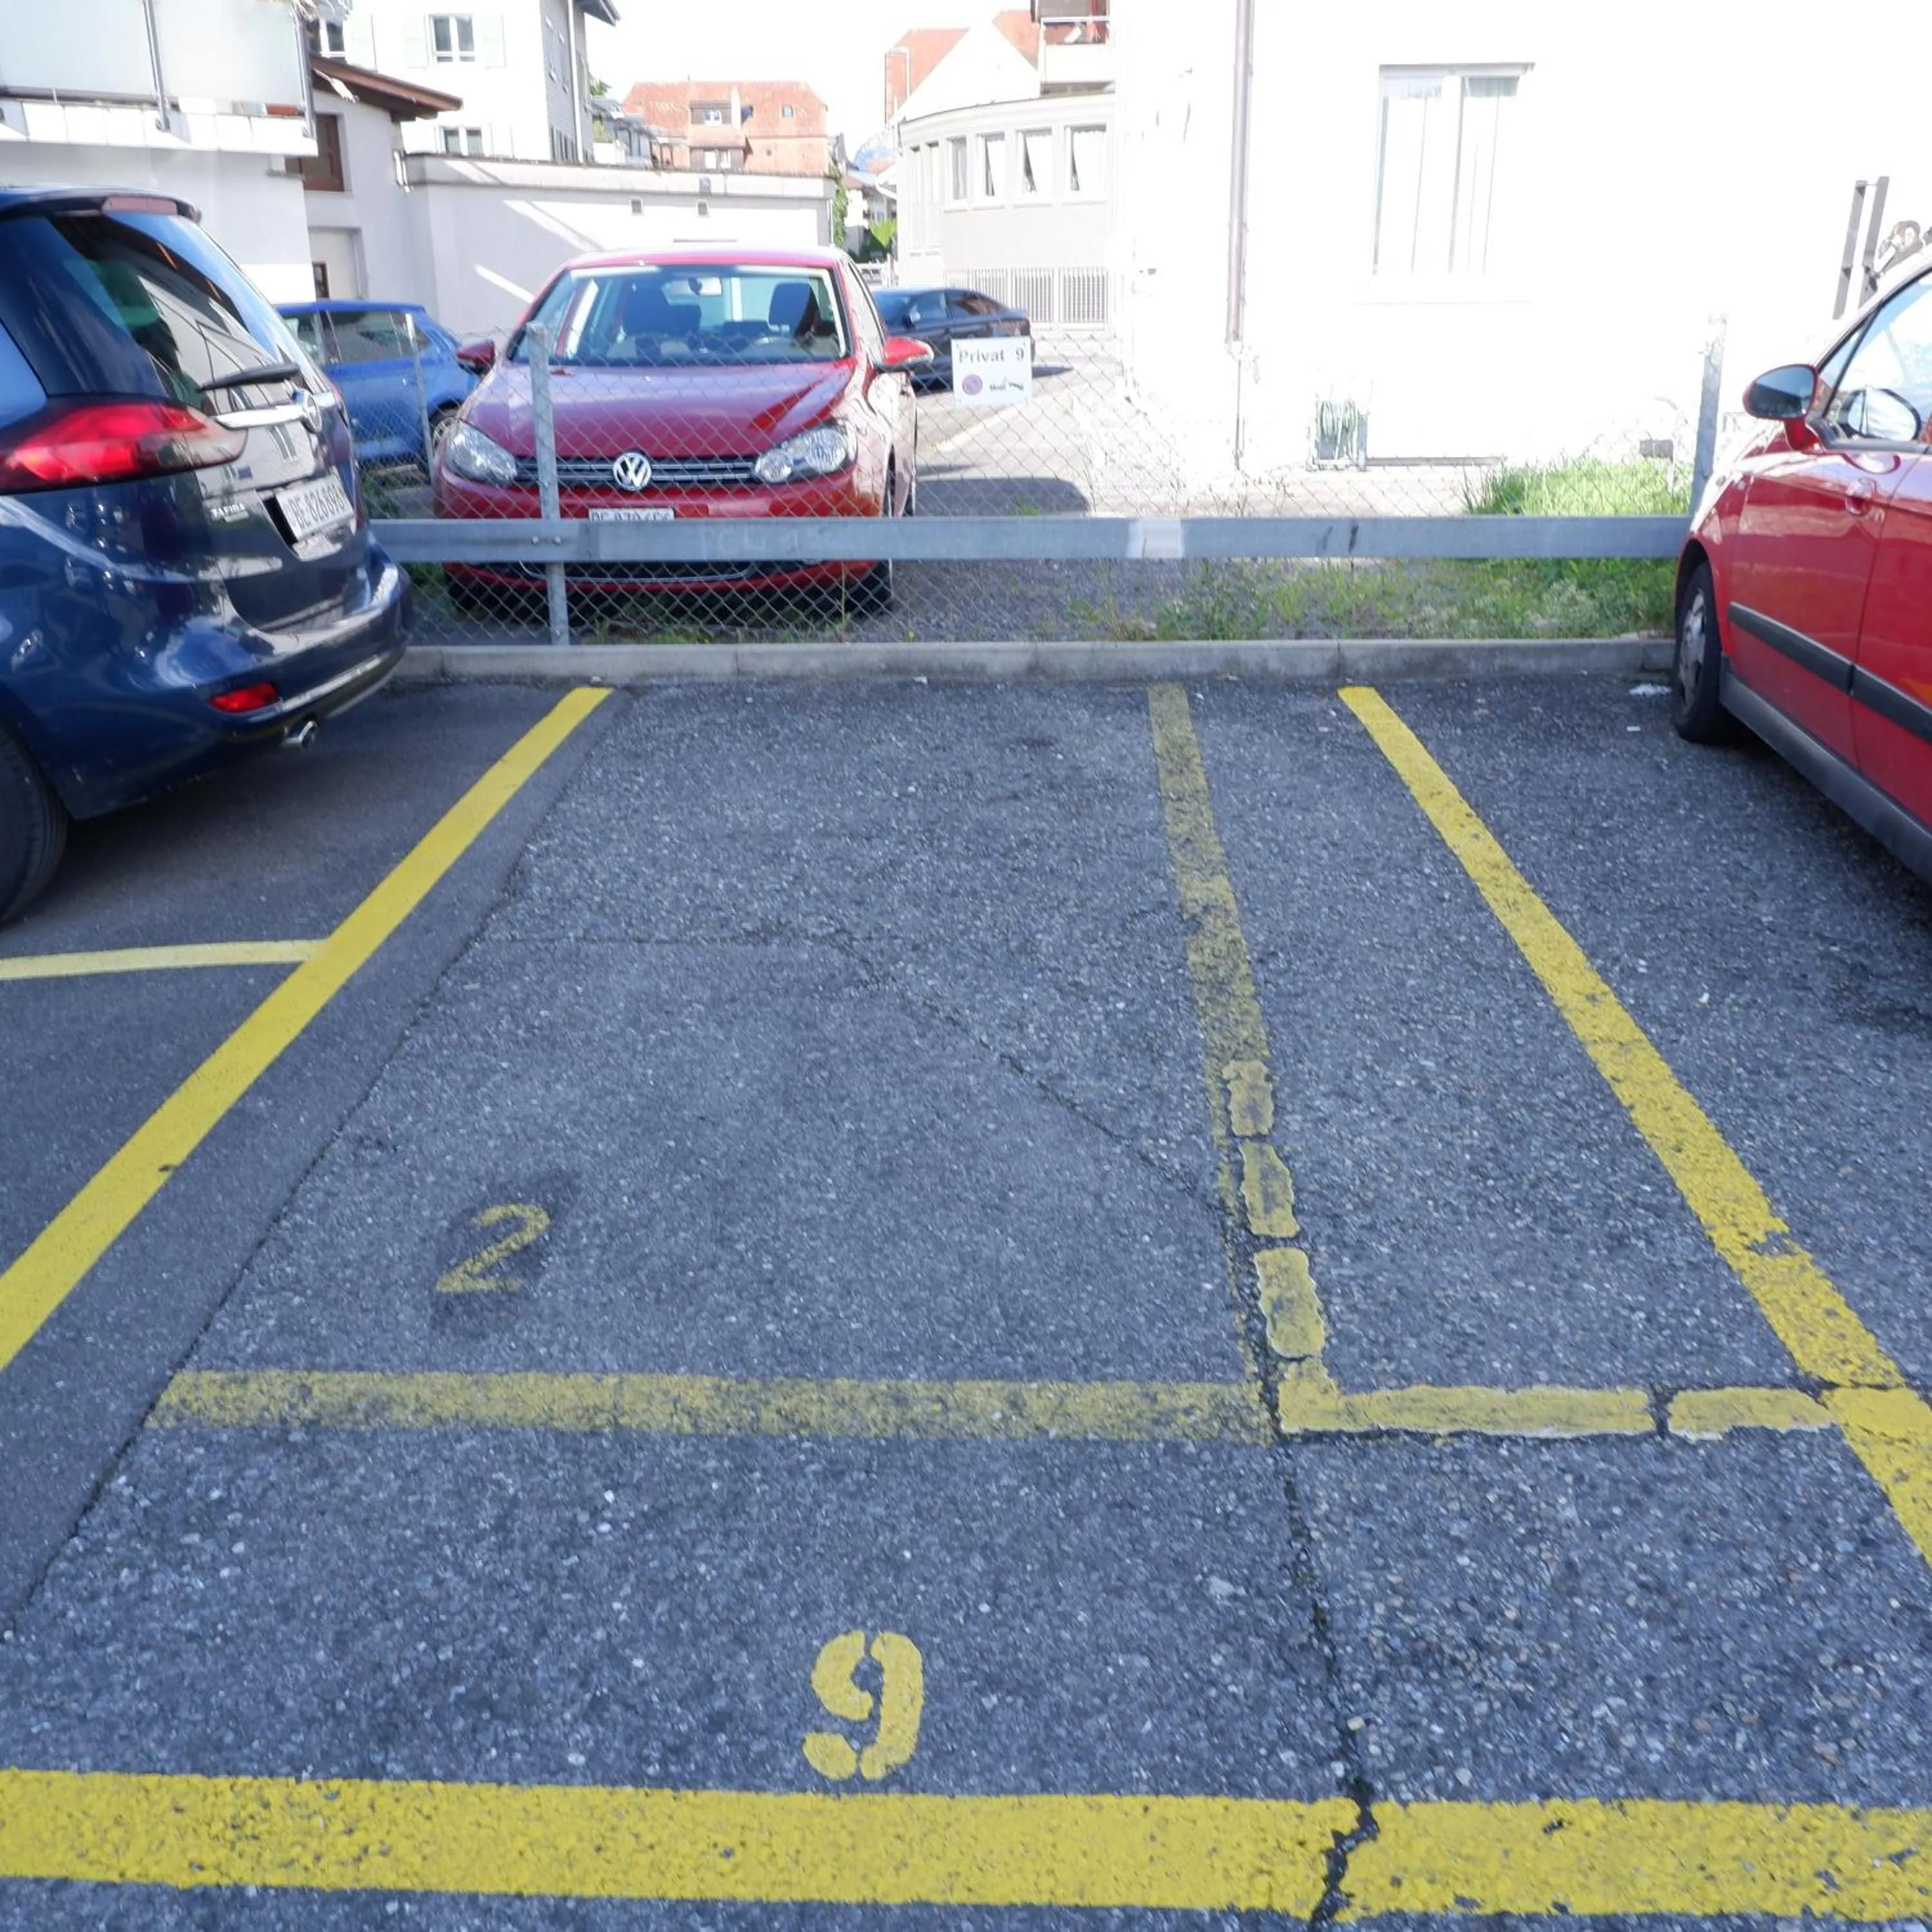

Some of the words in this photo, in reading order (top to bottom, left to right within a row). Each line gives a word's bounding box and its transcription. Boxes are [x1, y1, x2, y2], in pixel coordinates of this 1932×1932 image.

[960, 349, 1004, 364] Privat
[1016, 347, 1025, 361] 9
[437, 1202, 551, 1294] 2
[802, 1629, 925, 1781] 9
